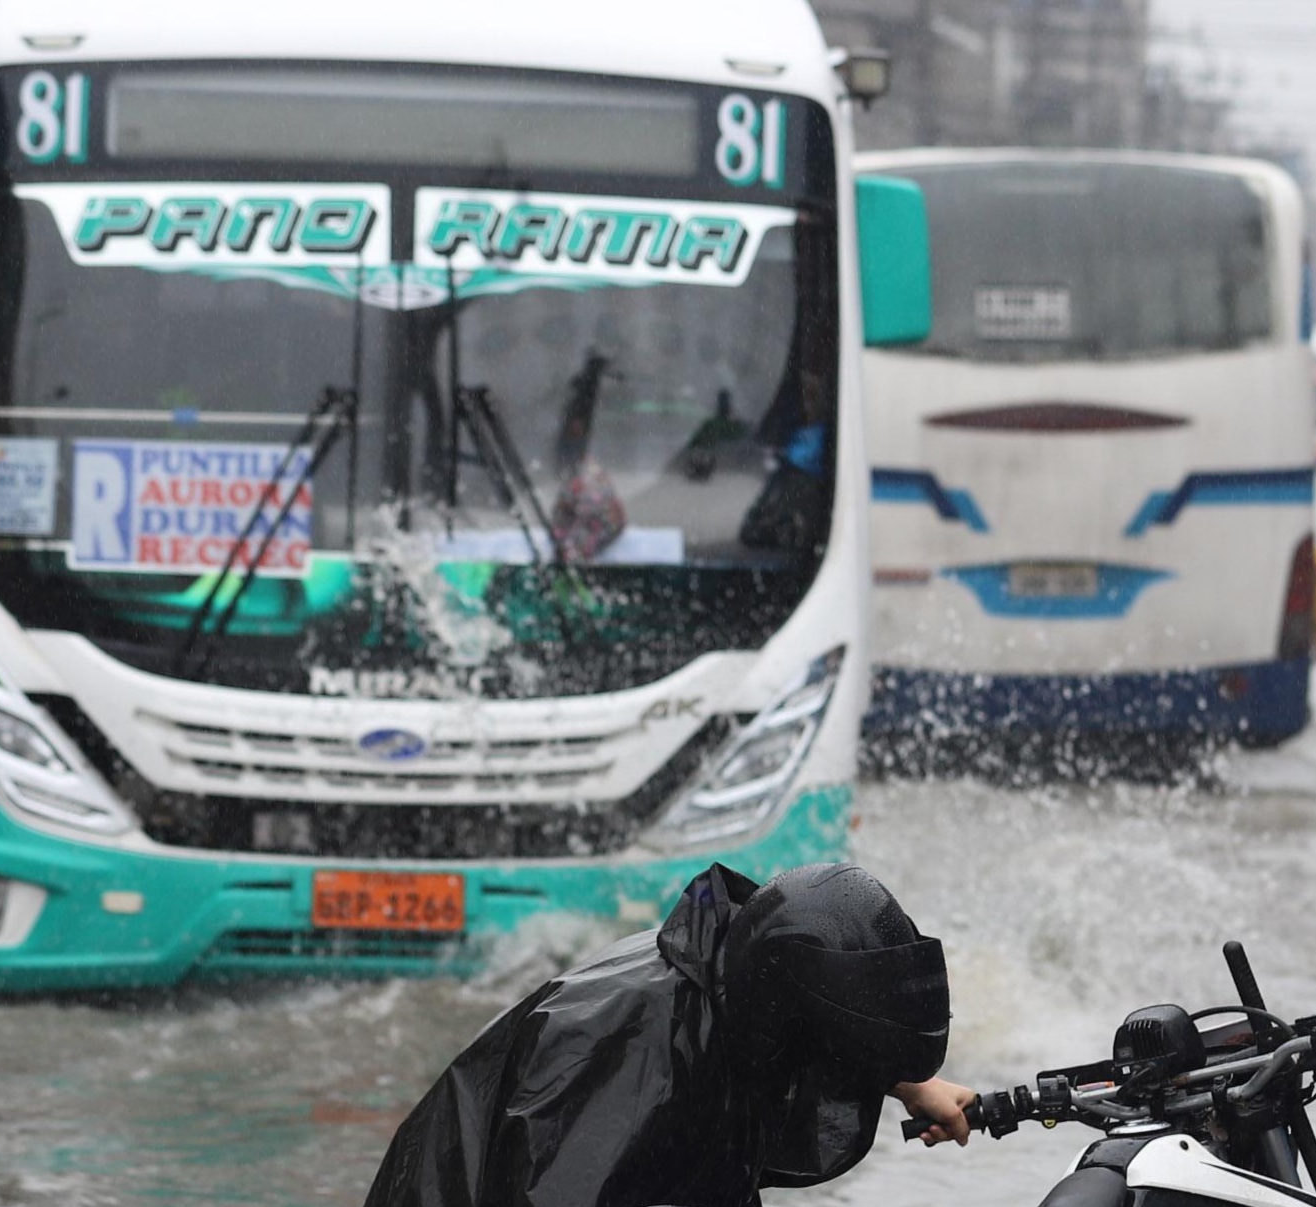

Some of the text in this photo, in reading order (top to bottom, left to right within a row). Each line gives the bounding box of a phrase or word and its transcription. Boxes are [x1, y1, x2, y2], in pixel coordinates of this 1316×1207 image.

[15, 71, 90, 163] 81
[715, 93, 787, 189] 81
[74, 197, 749, 275] PANO RAMA
[139, 477, 313, 509] AURORA
[141, 449, 314, 479] PUNTILLA
[75, 450, 128, 562] R
[140, 508, 311, 537] DURAN
